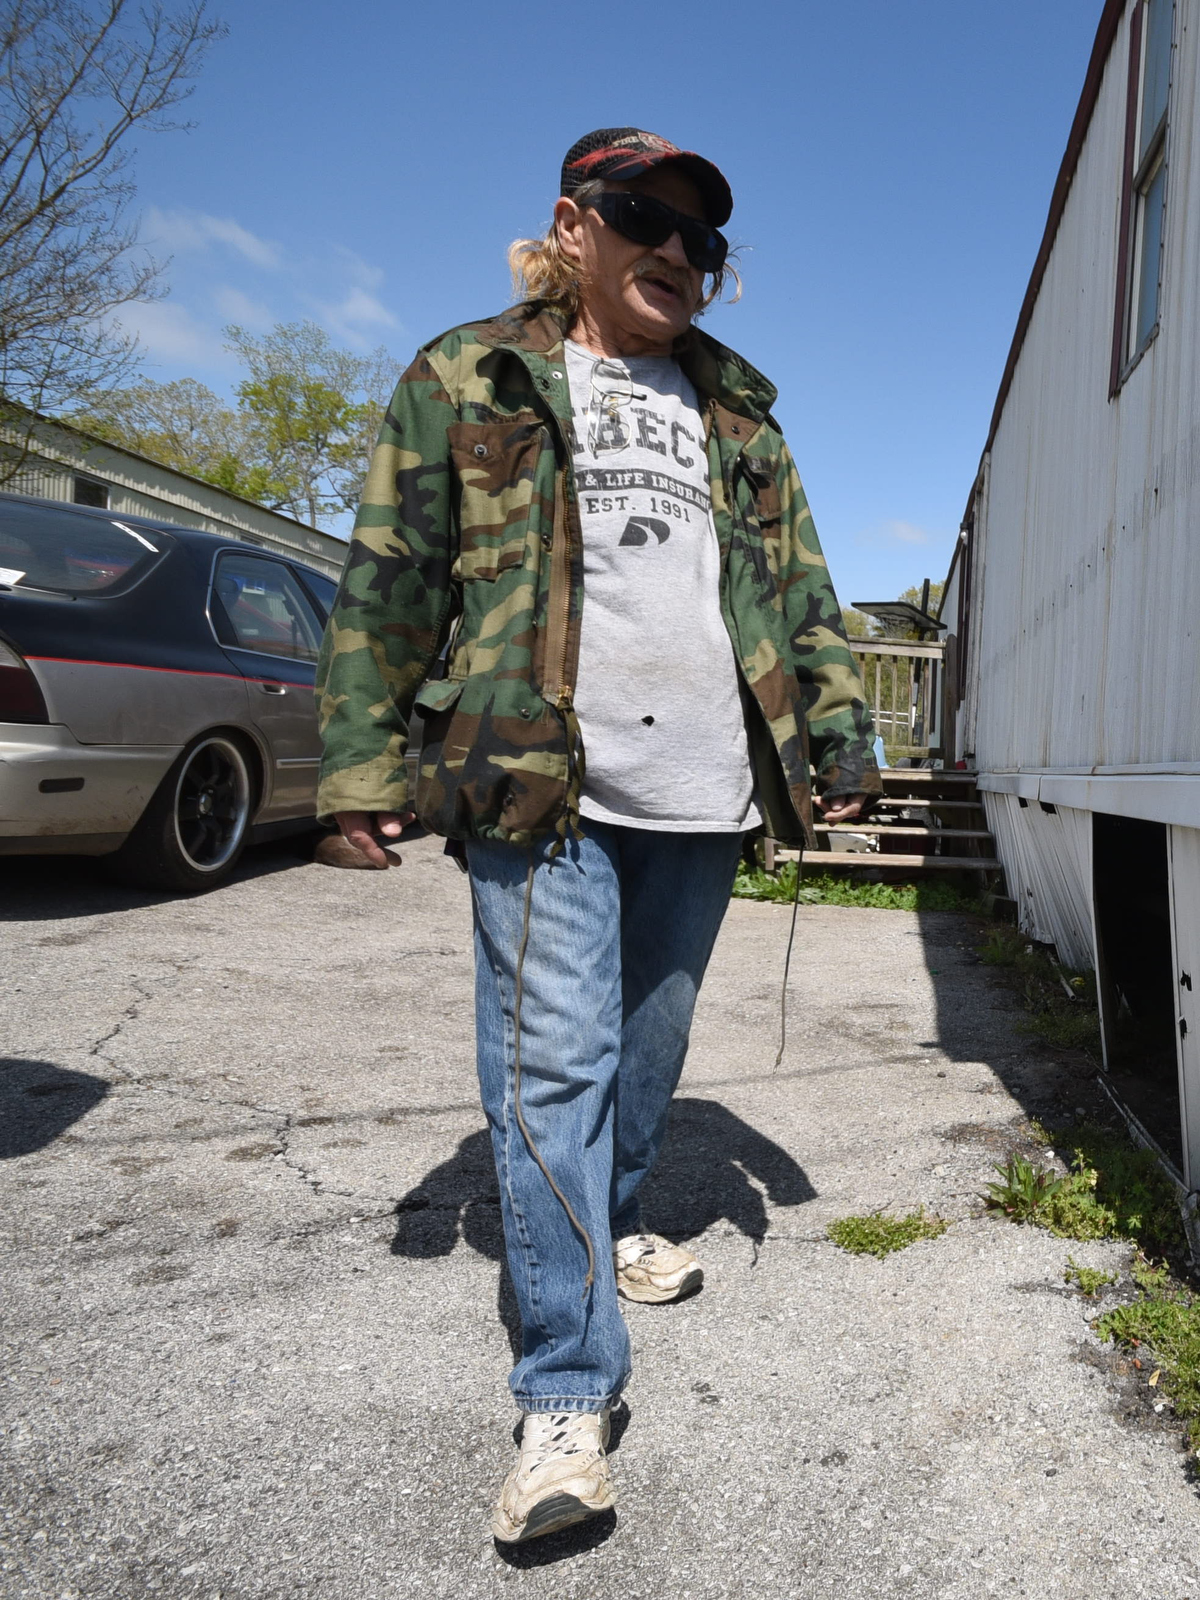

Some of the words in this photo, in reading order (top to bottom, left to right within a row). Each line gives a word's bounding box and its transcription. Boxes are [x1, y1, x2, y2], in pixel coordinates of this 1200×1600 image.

[584, 473, 598, 487] &
[605, 472, 645, 487] LIFE
[585, 495, 637, 515] EST.
[650, 496, 691, 523] 1991
